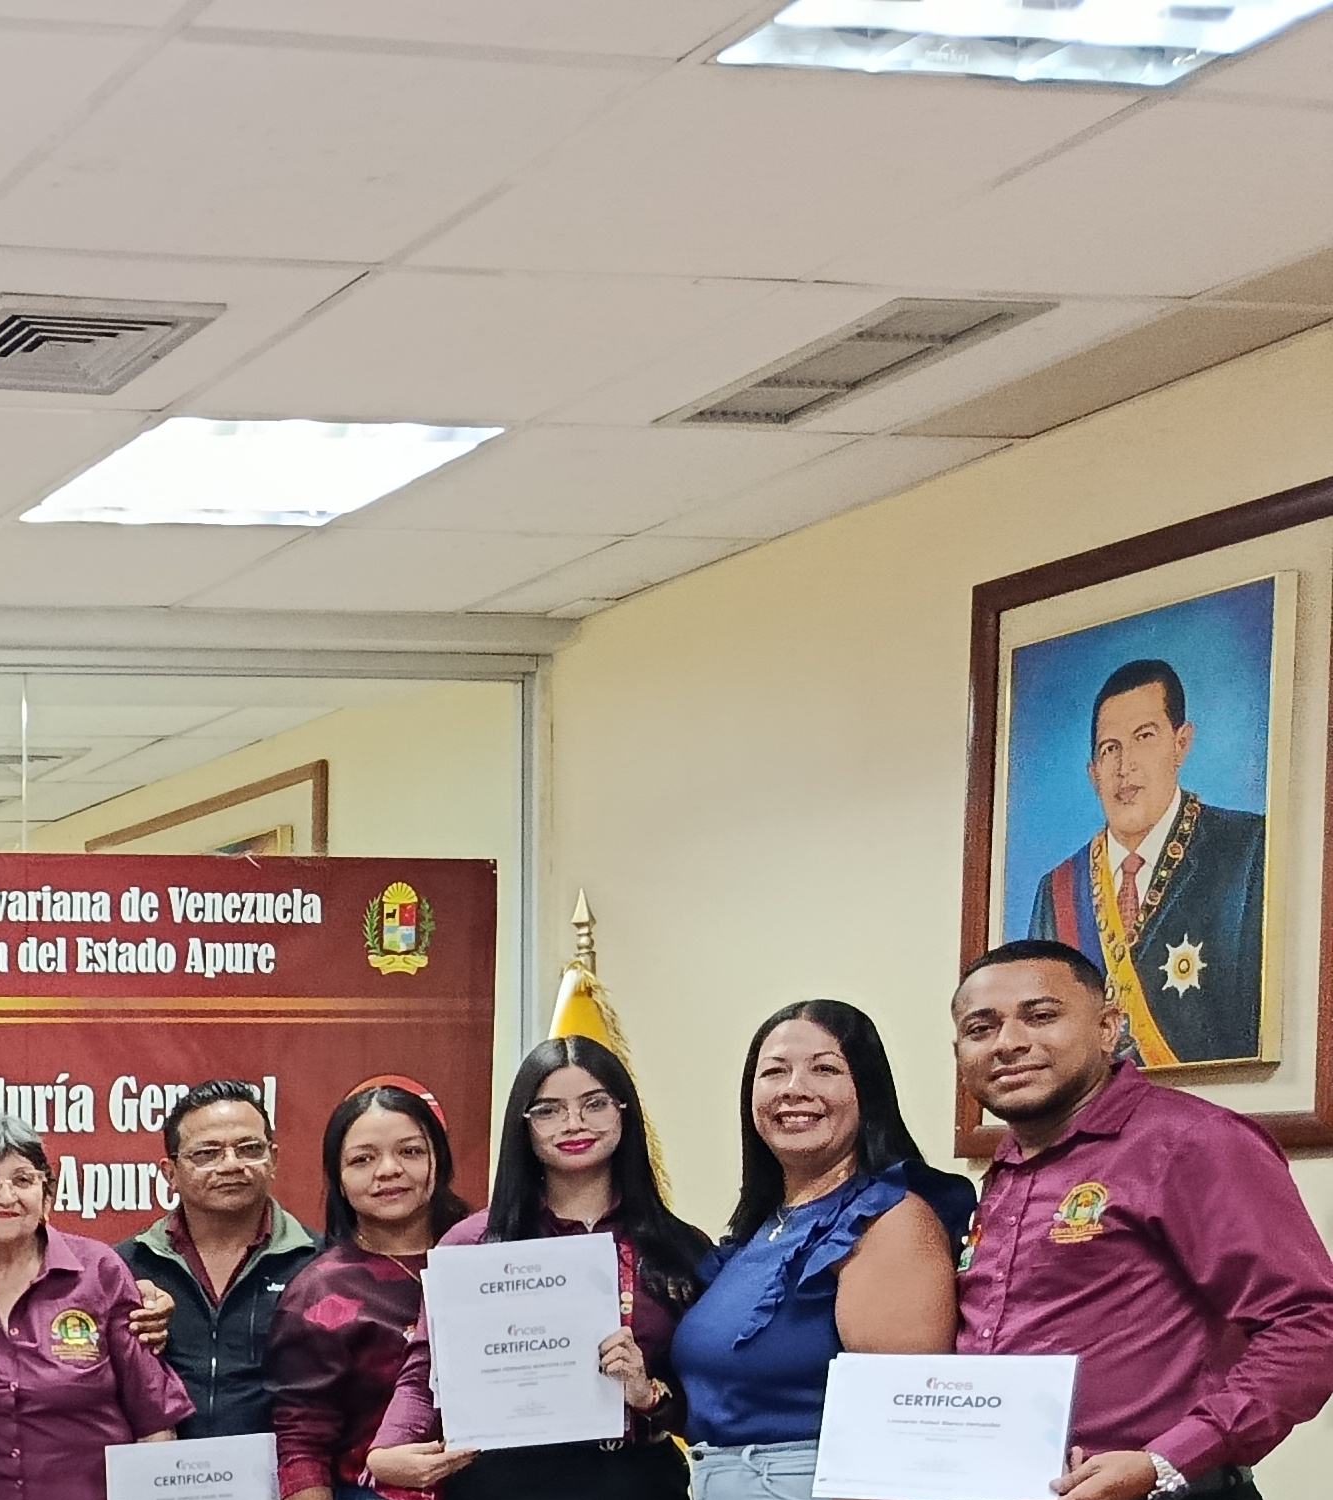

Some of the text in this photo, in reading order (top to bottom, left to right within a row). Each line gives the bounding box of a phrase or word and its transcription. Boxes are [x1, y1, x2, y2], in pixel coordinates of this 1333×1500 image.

[120, 887, 158, 923] de
[167, 887, 322, 924] Venezuela
[17, 937, 67, 973] del
[76, 937, 177, 973] Estado
[185, 937, 276, 978] Apure
[503, 1263, 542, 1275] inces
[479, 1274, 567, 1294] CERTIFICADO
[507, 1323, 547, 1337] inces
[484, 1337, 571, 1356] CERTIFICADO
[926, 1376, 974, 1391] inces
[892, 1393, 1002, 1408] CERTIFICADO
[154, 1470, 233, 1487] CERTIFICADO
